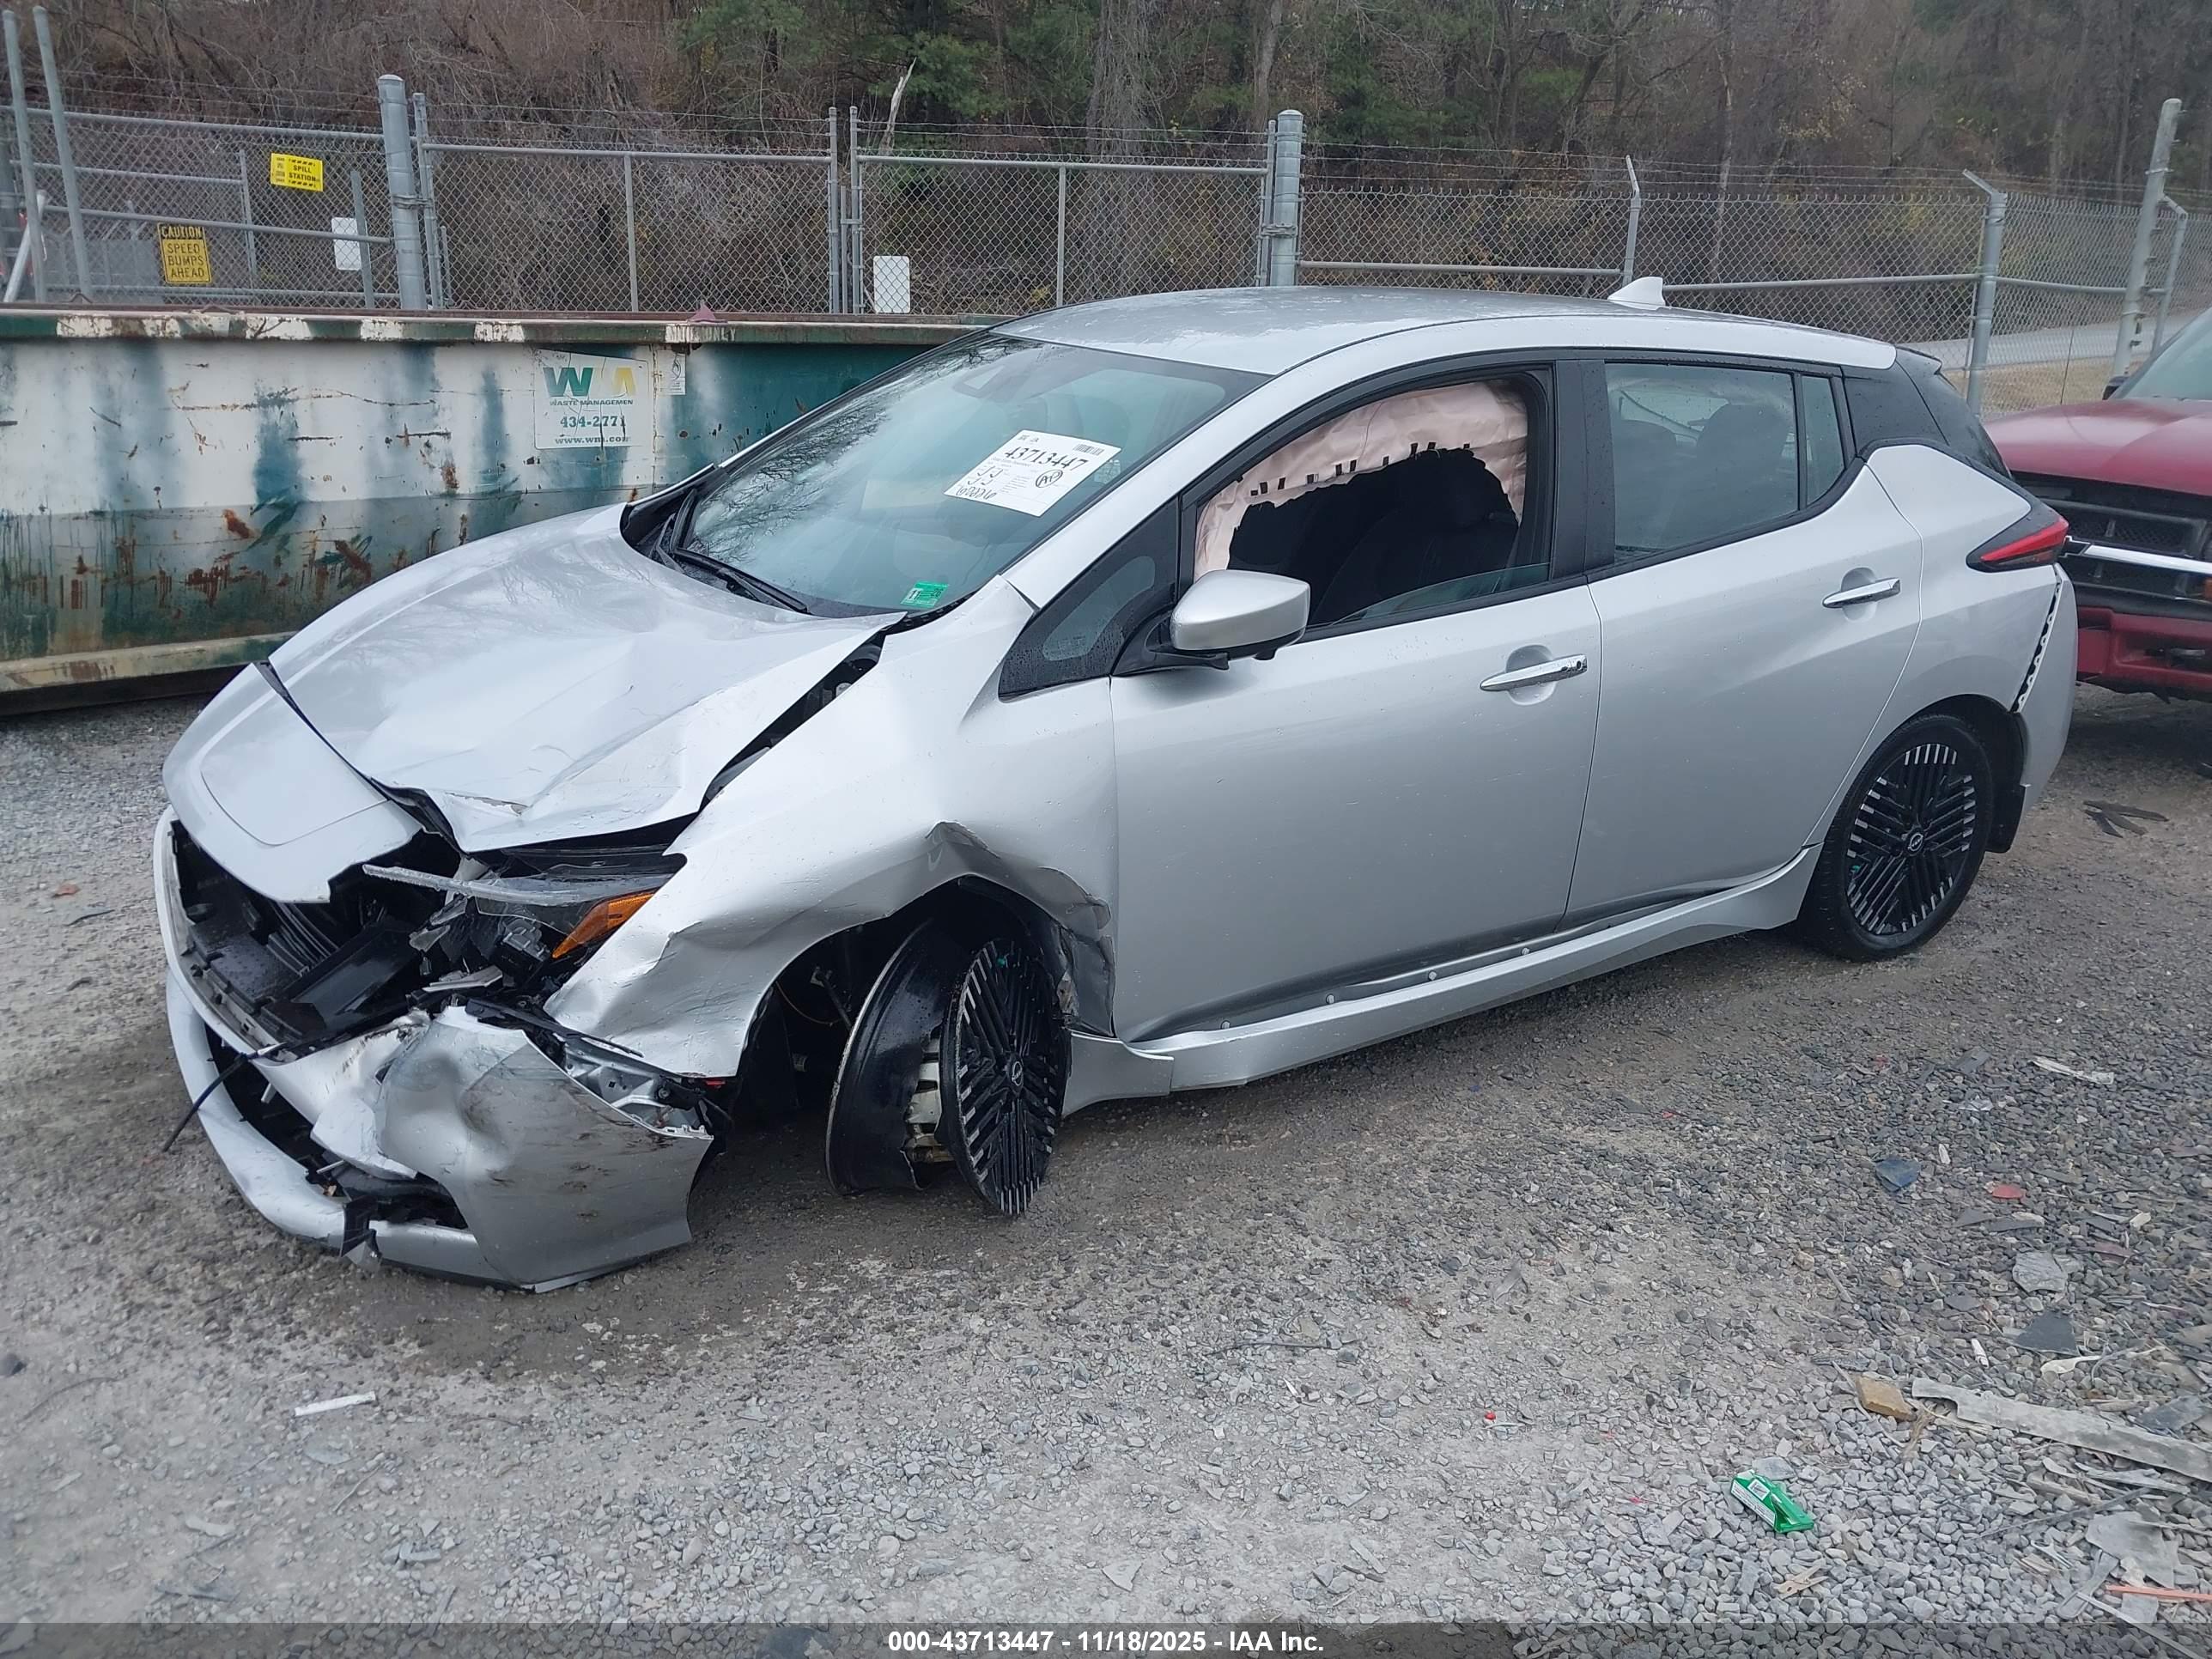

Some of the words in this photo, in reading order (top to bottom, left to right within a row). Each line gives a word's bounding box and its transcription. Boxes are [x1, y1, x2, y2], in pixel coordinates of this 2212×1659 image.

[293, 164, 312, 173] SPILL
[289, 172, 316, 182] STATION
[161, 225, 203, 238] CAUTION
[167, 242, 200, 254] SPEED
[167, 255, 204, 266] BUMPS
[171, 267, 204, 278] AHEAD
[560, 416, 626, 428] 434-2771
[1003, 446, 1089, 471] 43713447
